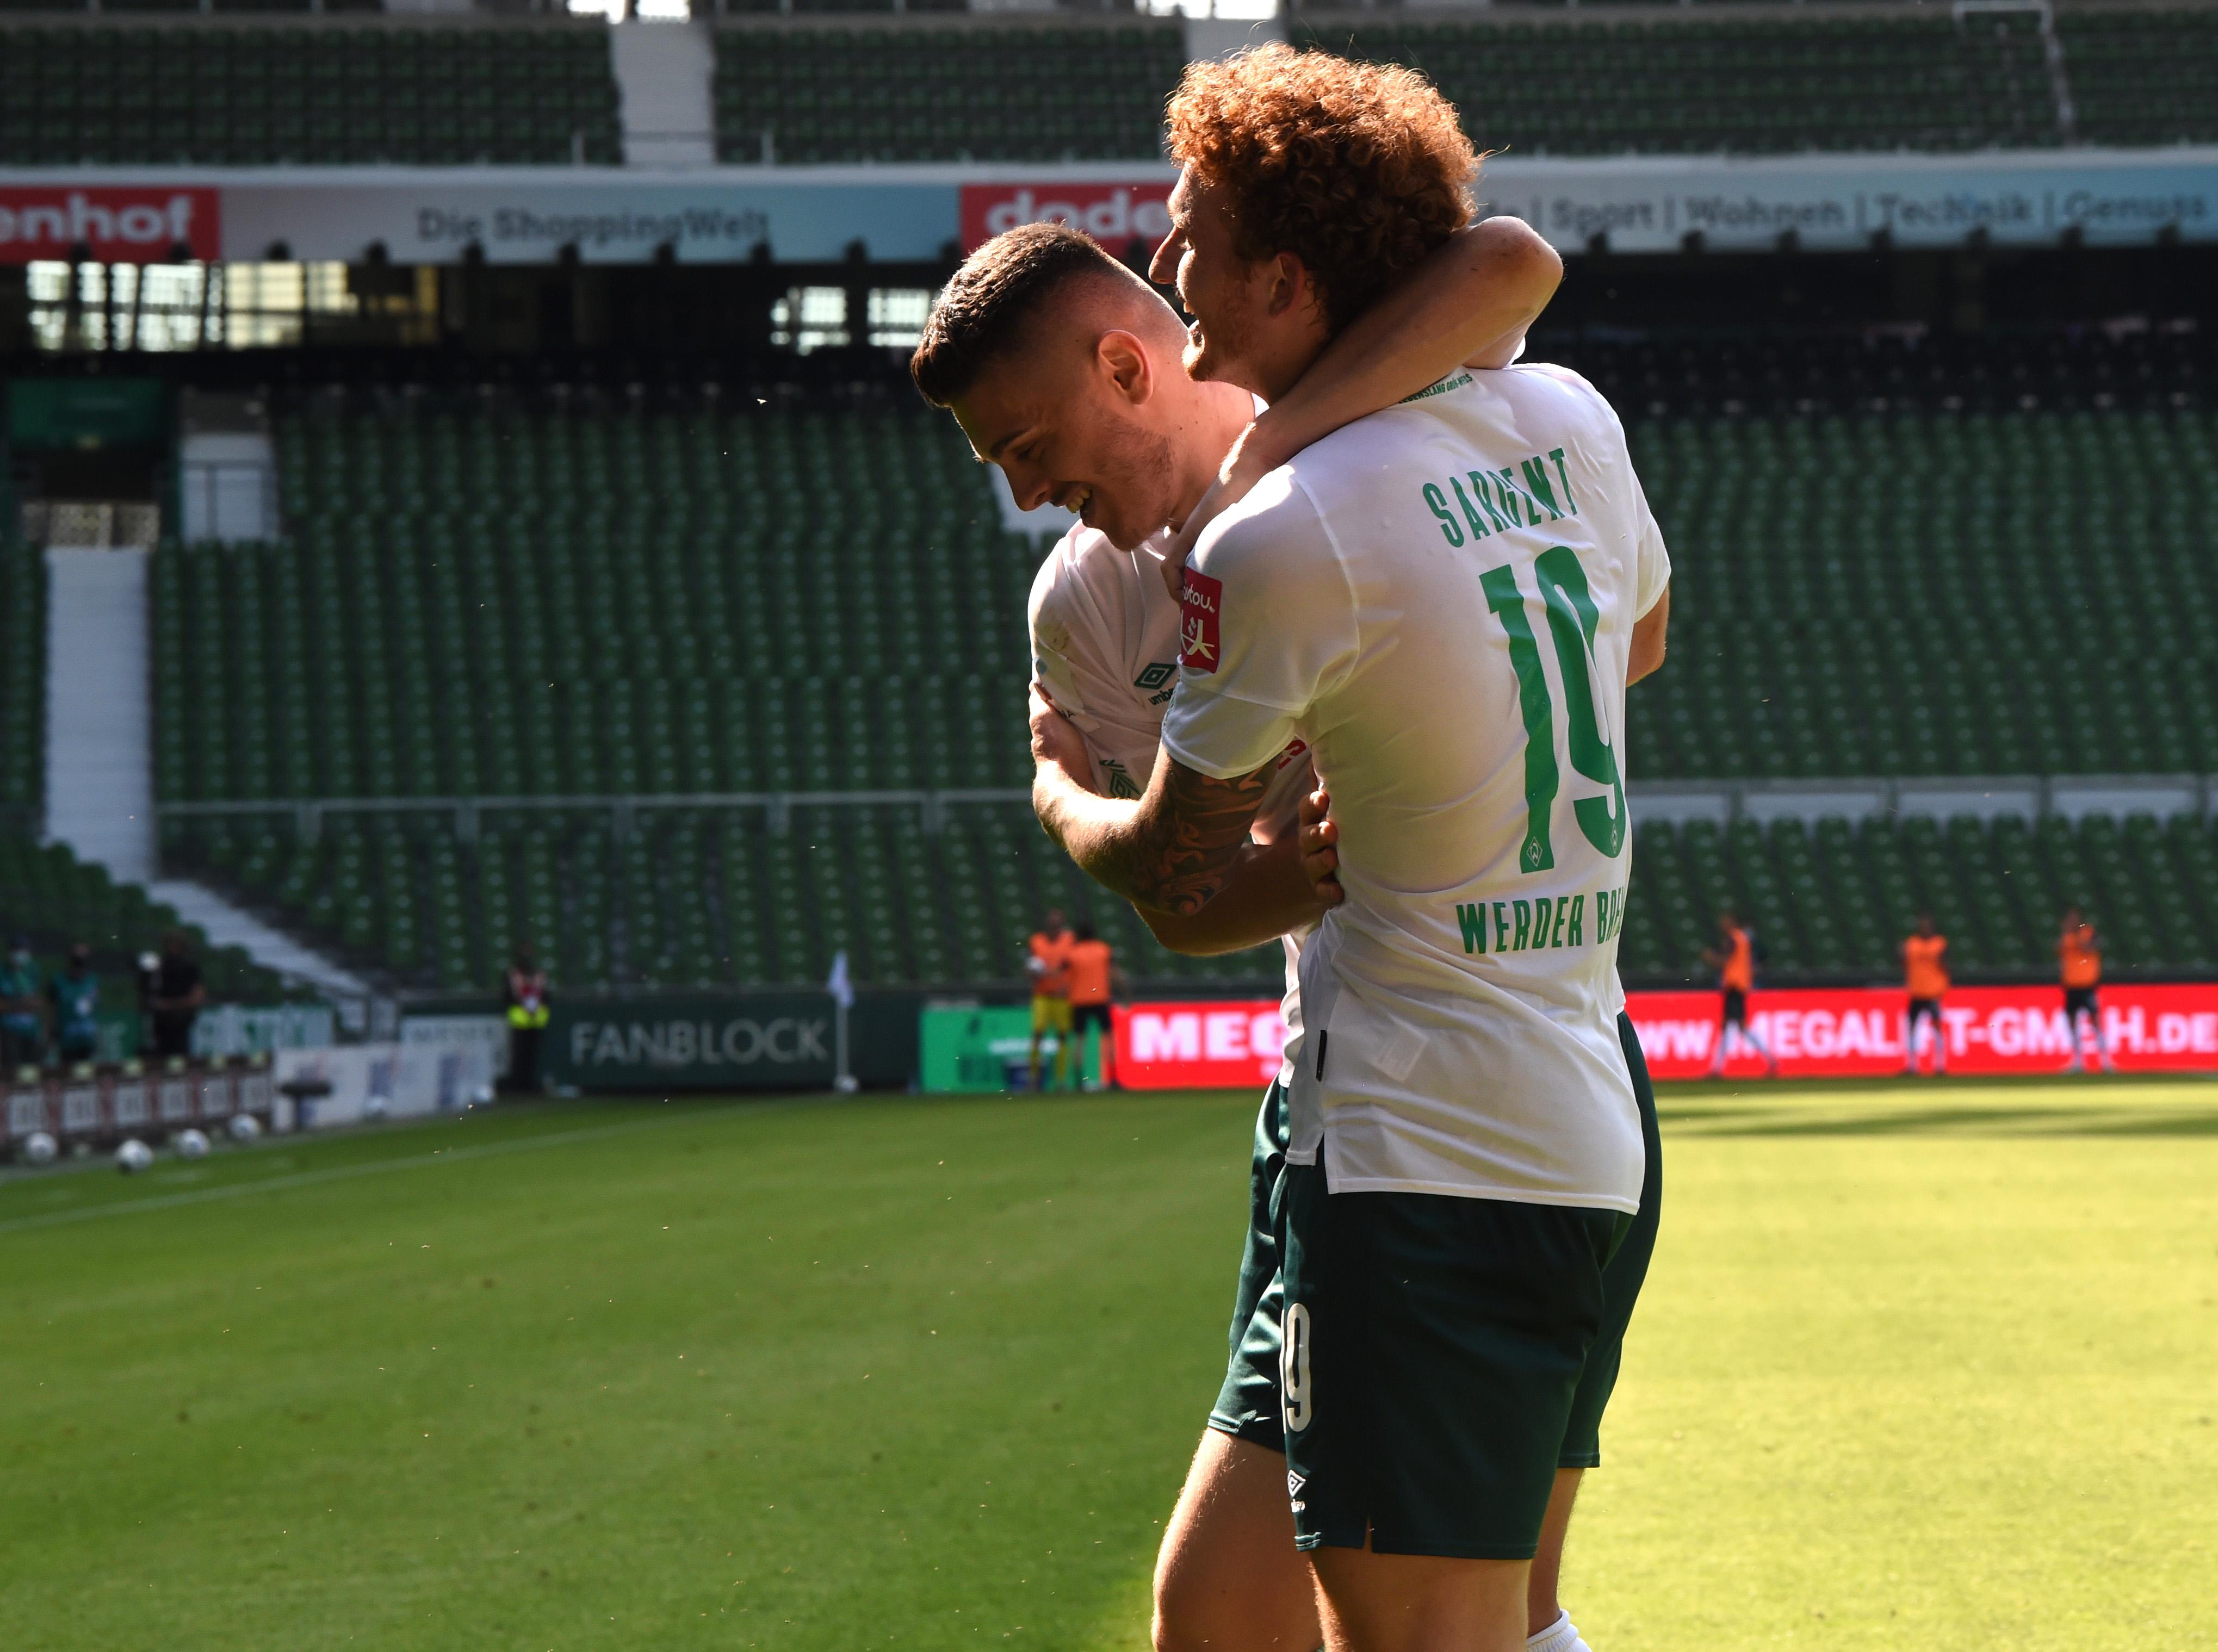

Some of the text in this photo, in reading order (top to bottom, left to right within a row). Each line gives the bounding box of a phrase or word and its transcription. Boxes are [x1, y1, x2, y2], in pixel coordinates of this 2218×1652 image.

[416, 207, 484, 241] Die
[1550, 196, 1655, 238] Sport
[1684, 194, 1844, 227] Wohnen
[1876, 192, 2032, 226] Technik
[1422, 448, 1577, 548] SARGENT
[1479, 545, 1626, 874] 19
[1456, 895, 1584, 954] WERDER
[571, 1018, 827, 1065] FANBLOCK
